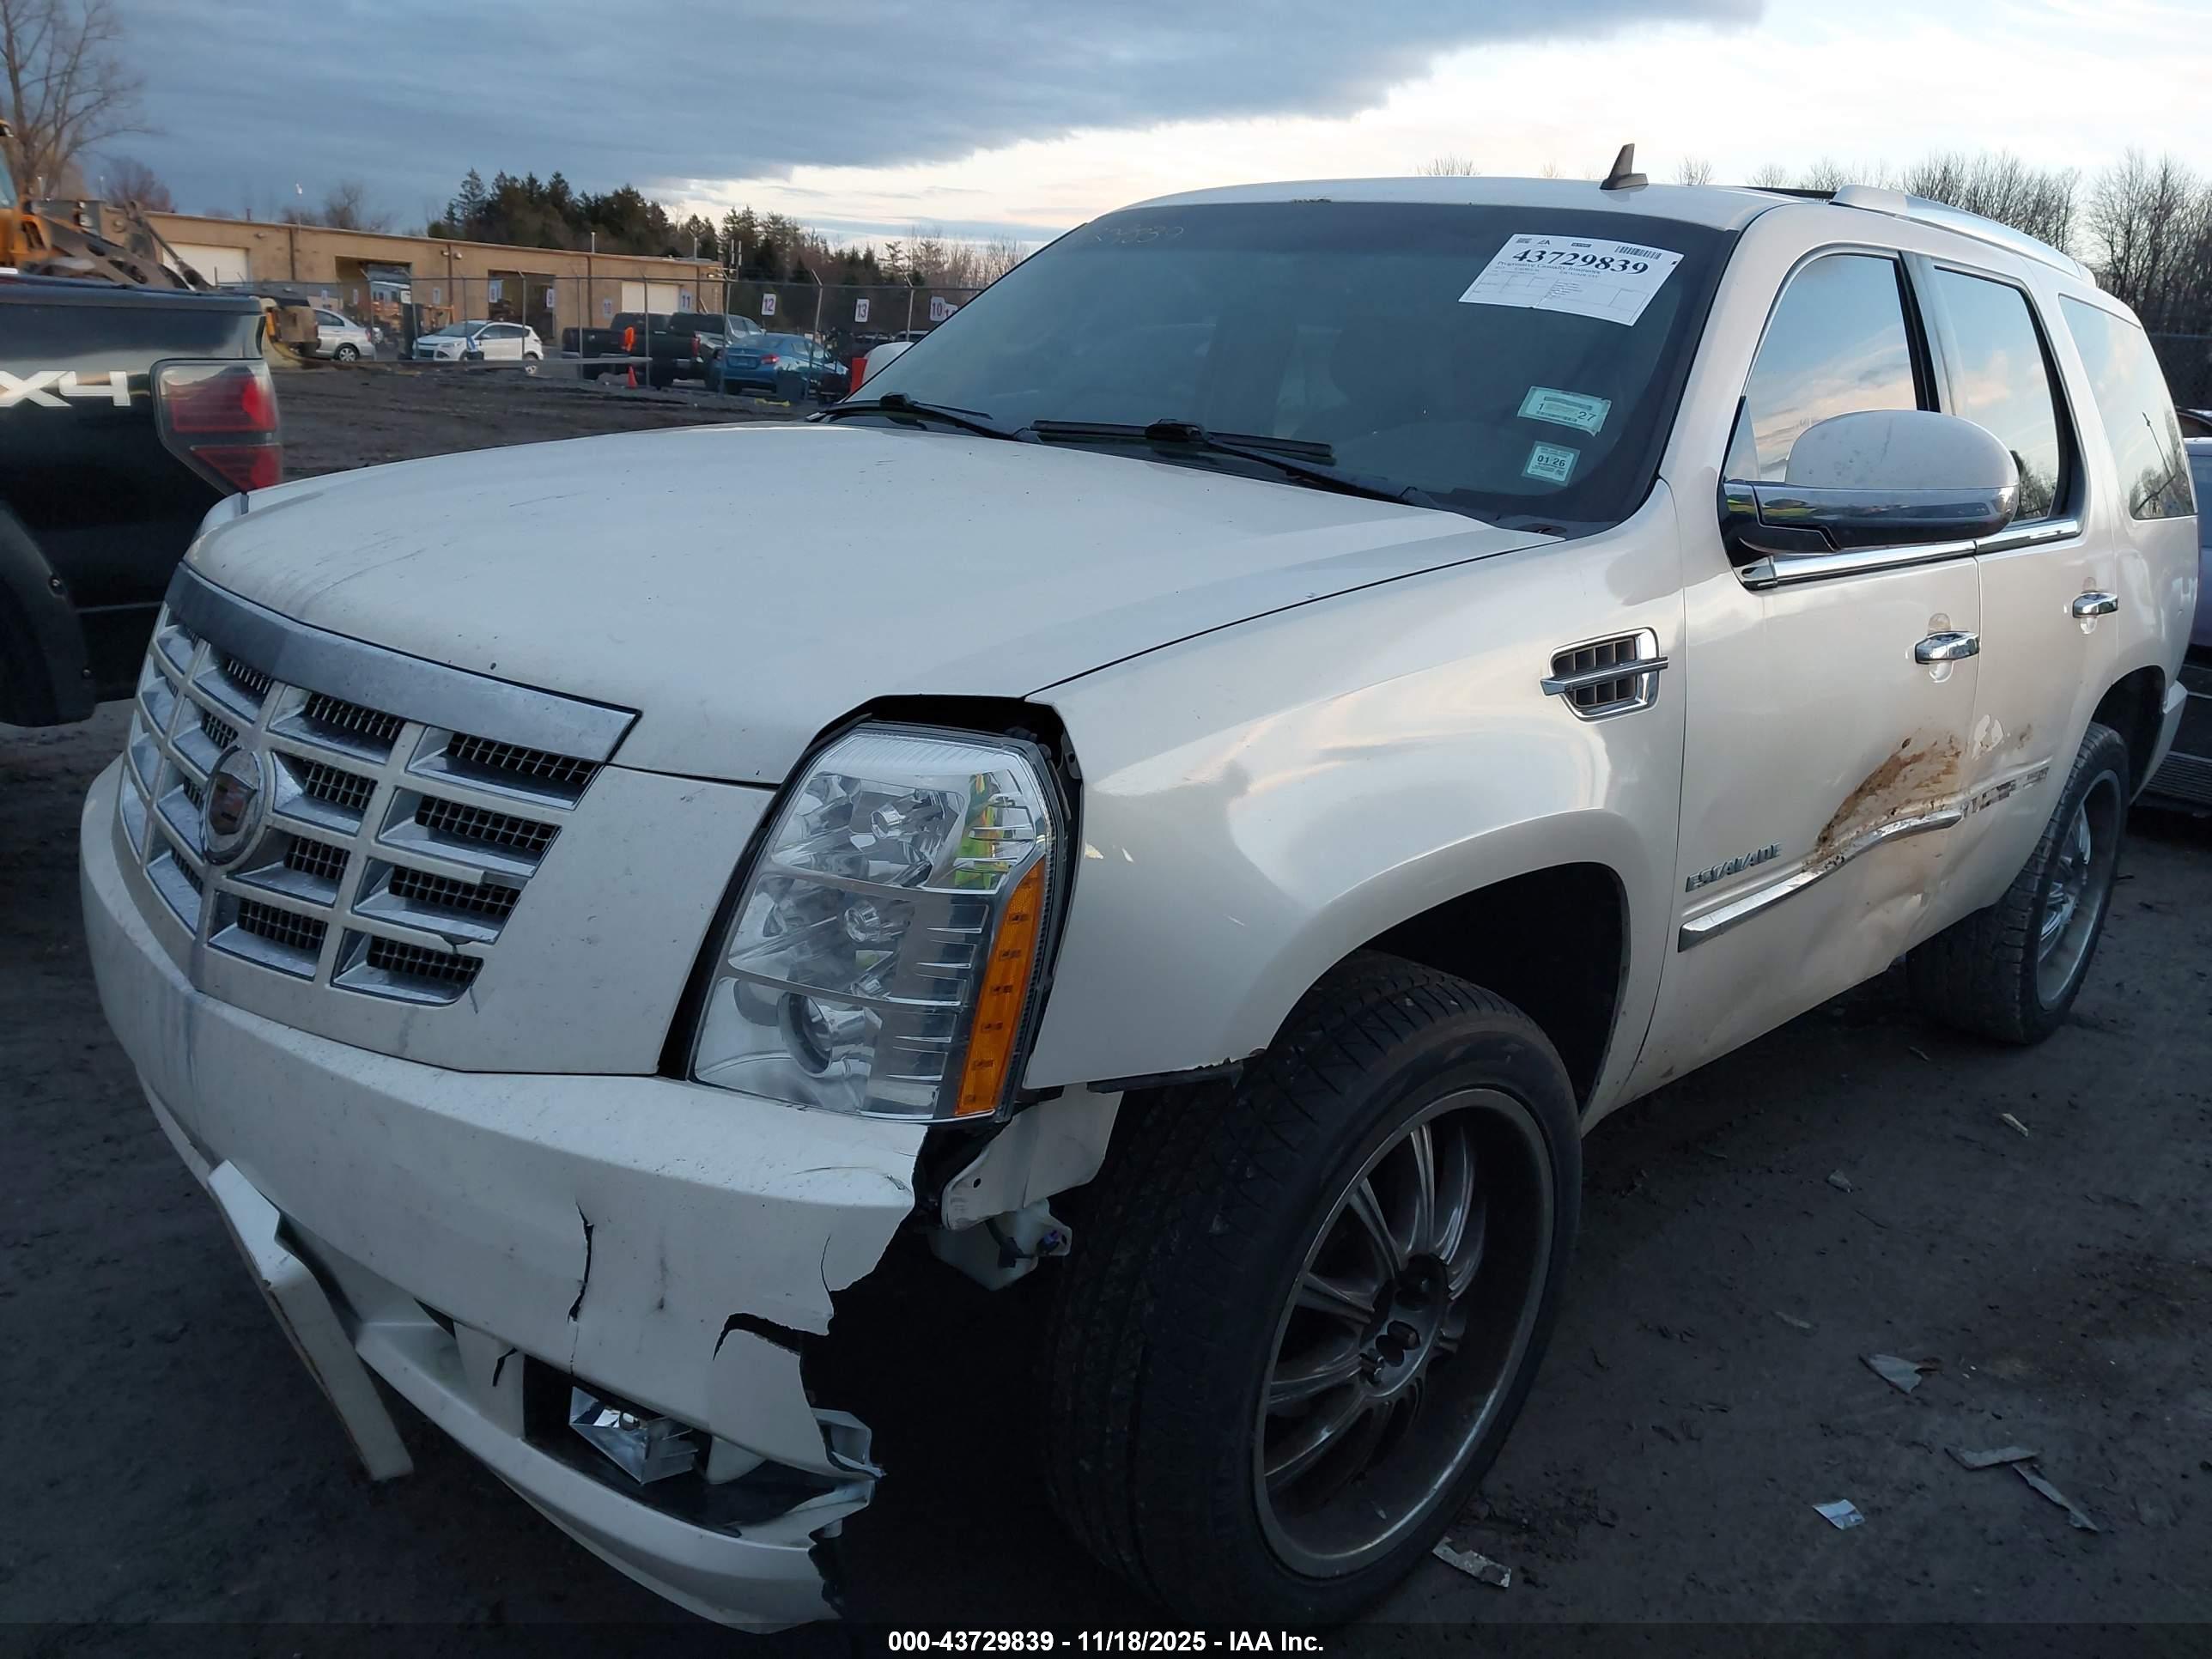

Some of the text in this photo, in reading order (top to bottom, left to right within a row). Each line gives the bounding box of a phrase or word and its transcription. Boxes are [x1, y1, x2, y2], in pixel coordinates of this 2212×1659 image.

[1512, 249, 1649, 275] 43729839
[763, 297, 774, 312] 12
[857, 303, 867, 319] 13
[931, 302, 943, 317] 10
[1578, 411, 1597, 422] 27
[1686, 842, 1782, 892] ESCALADE
